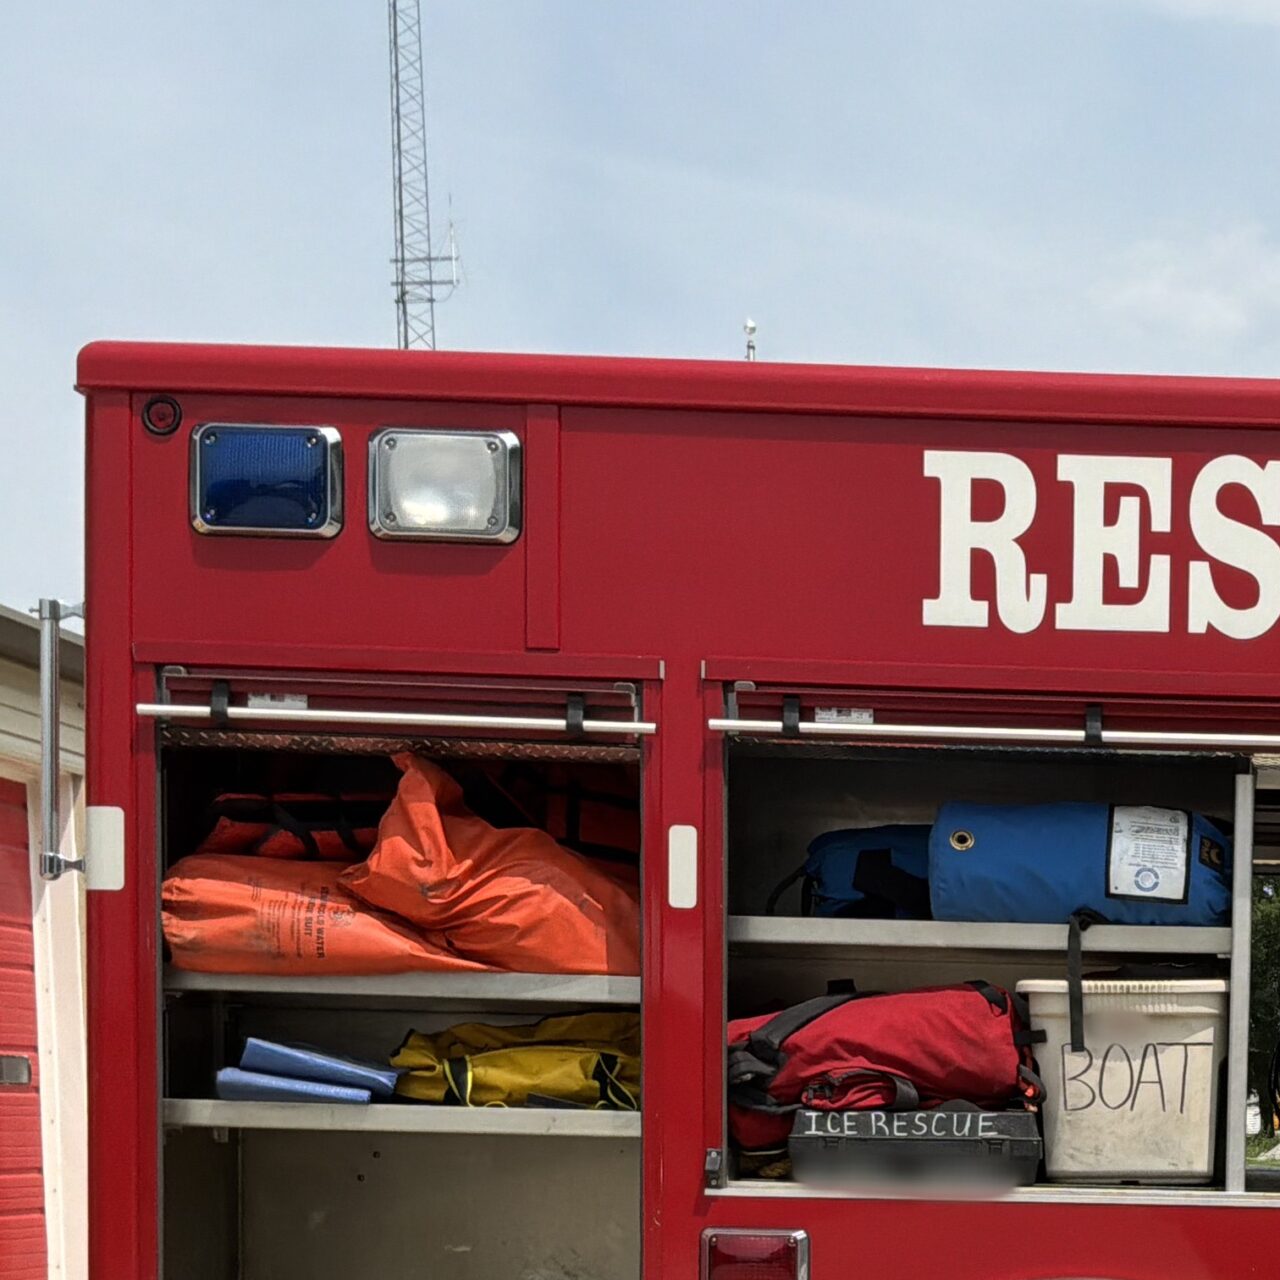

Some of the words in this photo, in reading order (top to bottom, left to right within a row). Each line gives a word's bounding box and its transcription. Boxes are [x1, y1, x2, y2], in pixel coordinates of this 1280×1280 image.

[304, 916, 313, 937] SUIT
[316, 927, 325, 959] WATER
[1061, 1042, 1214, 1114] BOAT
[804, 1111, 858, 1136] ICE
[871, 1111, 999, 1137] RESCUE
